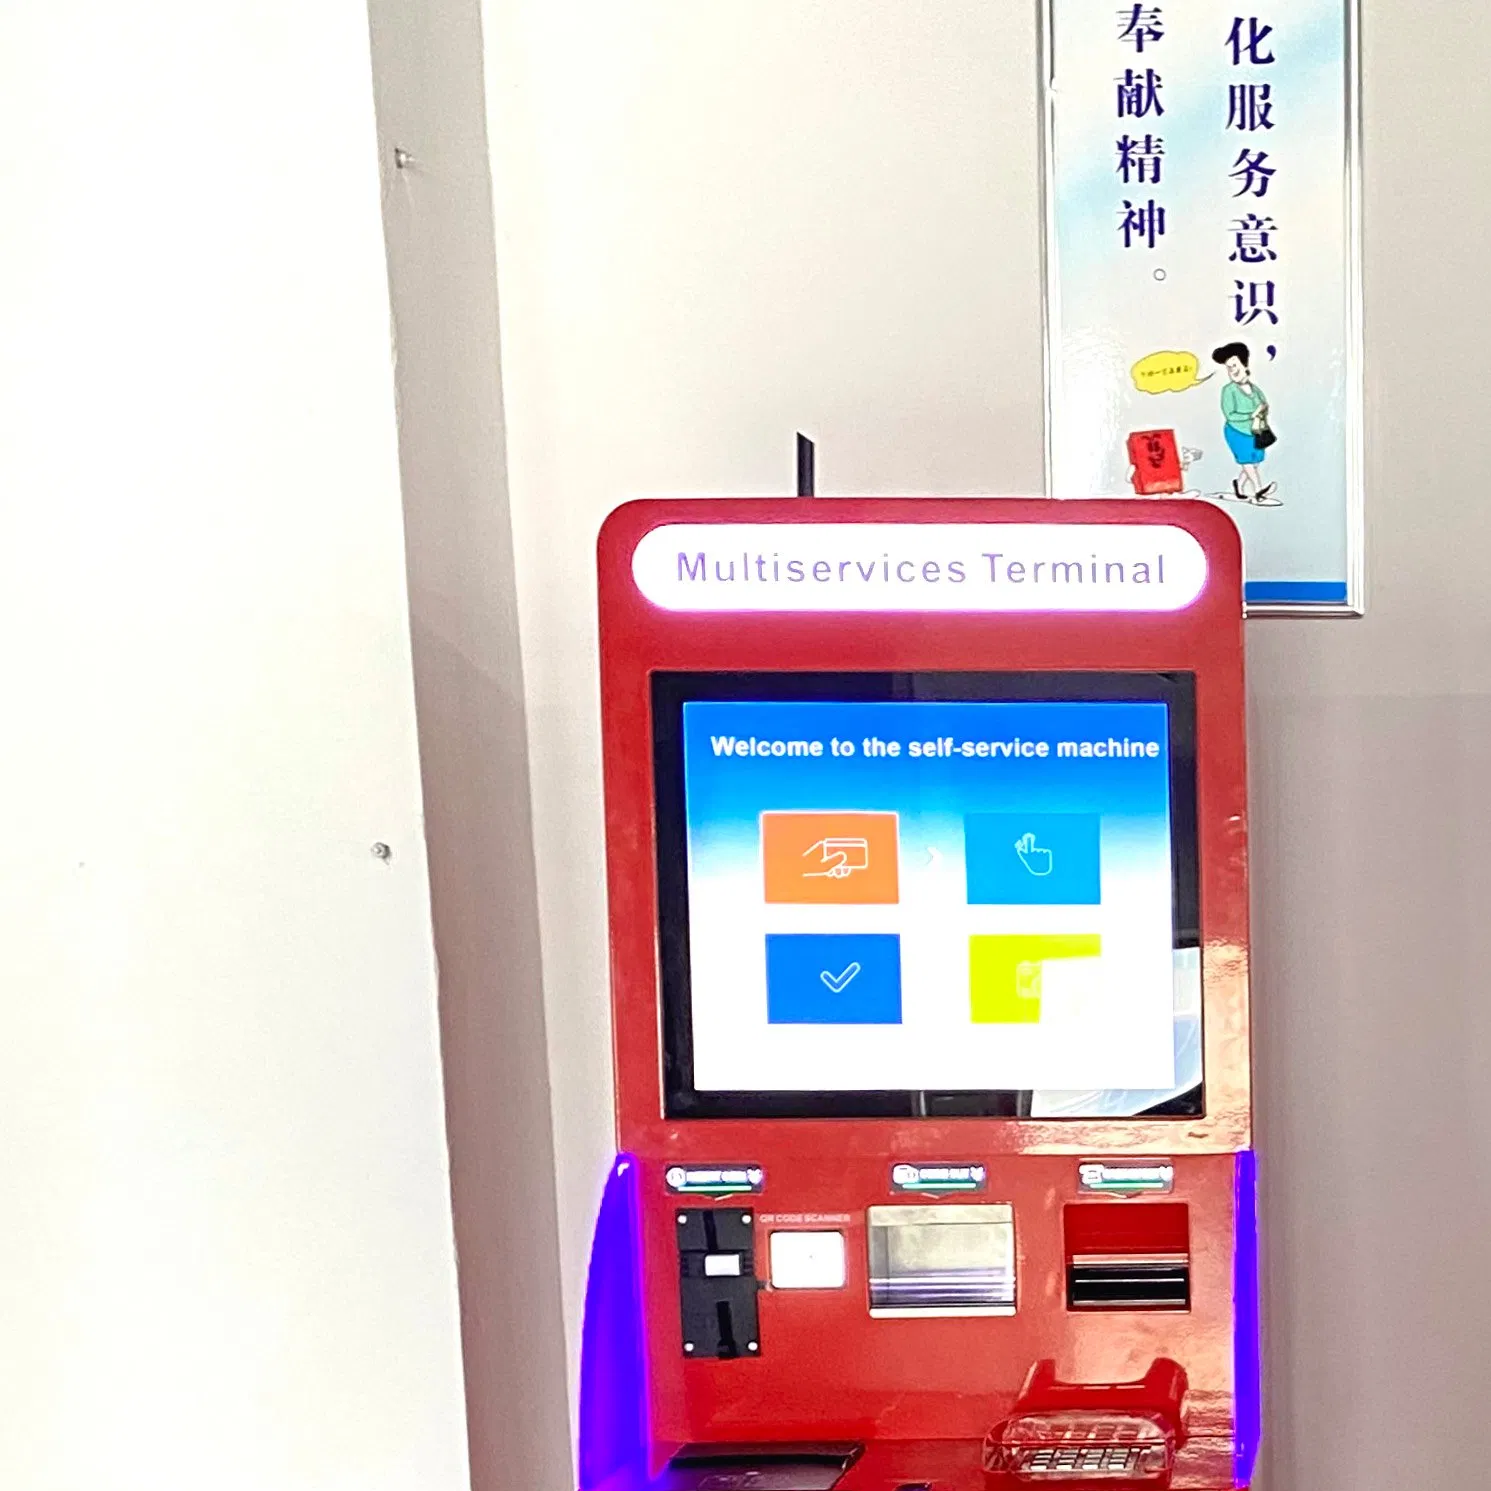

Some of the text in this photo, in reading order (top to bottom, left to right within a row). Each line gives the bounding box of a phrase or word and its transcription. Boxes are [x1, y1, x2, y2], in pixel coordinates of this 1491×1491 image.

[676, 551, 1166, 585] Multiservices Terminal
[710, 735, 1160, 758] Welcome to the self-service machine
